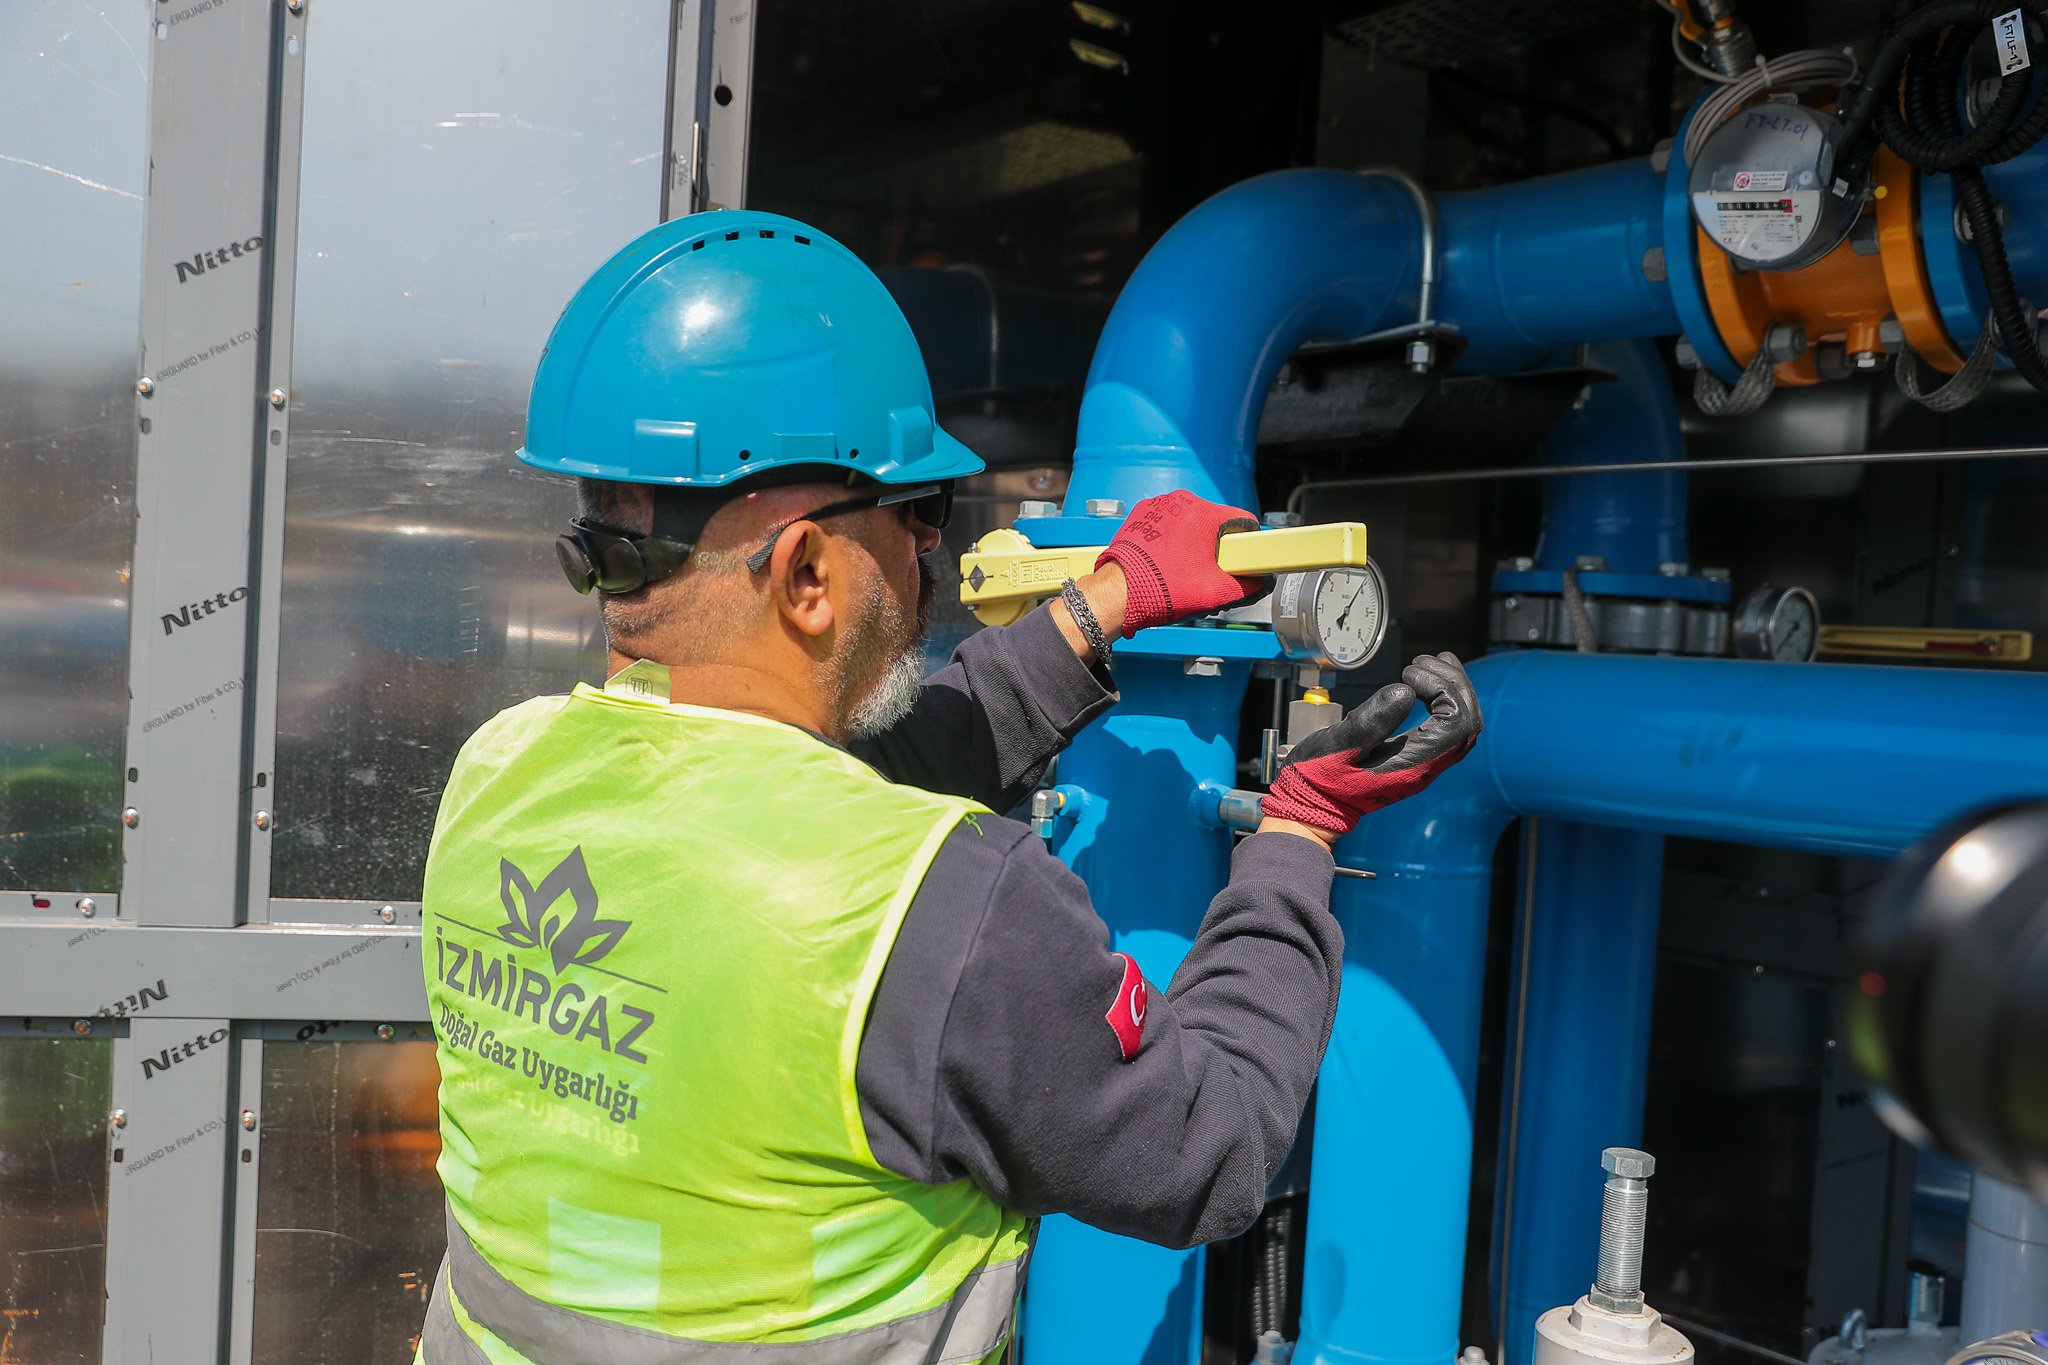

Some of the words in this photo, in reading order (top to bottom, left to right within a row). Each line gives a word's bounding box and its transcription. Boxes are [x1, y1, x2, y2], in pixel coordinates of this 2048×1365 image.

[2004, 24, 2018, 61] FT/LF-1
[174, 236, 264, 283] Nitto
[160, 587, 249, 636] Nitto
[436, 926, 655, 1065] İZMİRGAZ
[140, 1028, 231, 1080] Nitto
[439, 1002, 480, 1050] Doğal
[478, 1030, 517, 1070] Gaz
[522, 1046, 638, 1124] Uygarlığı
